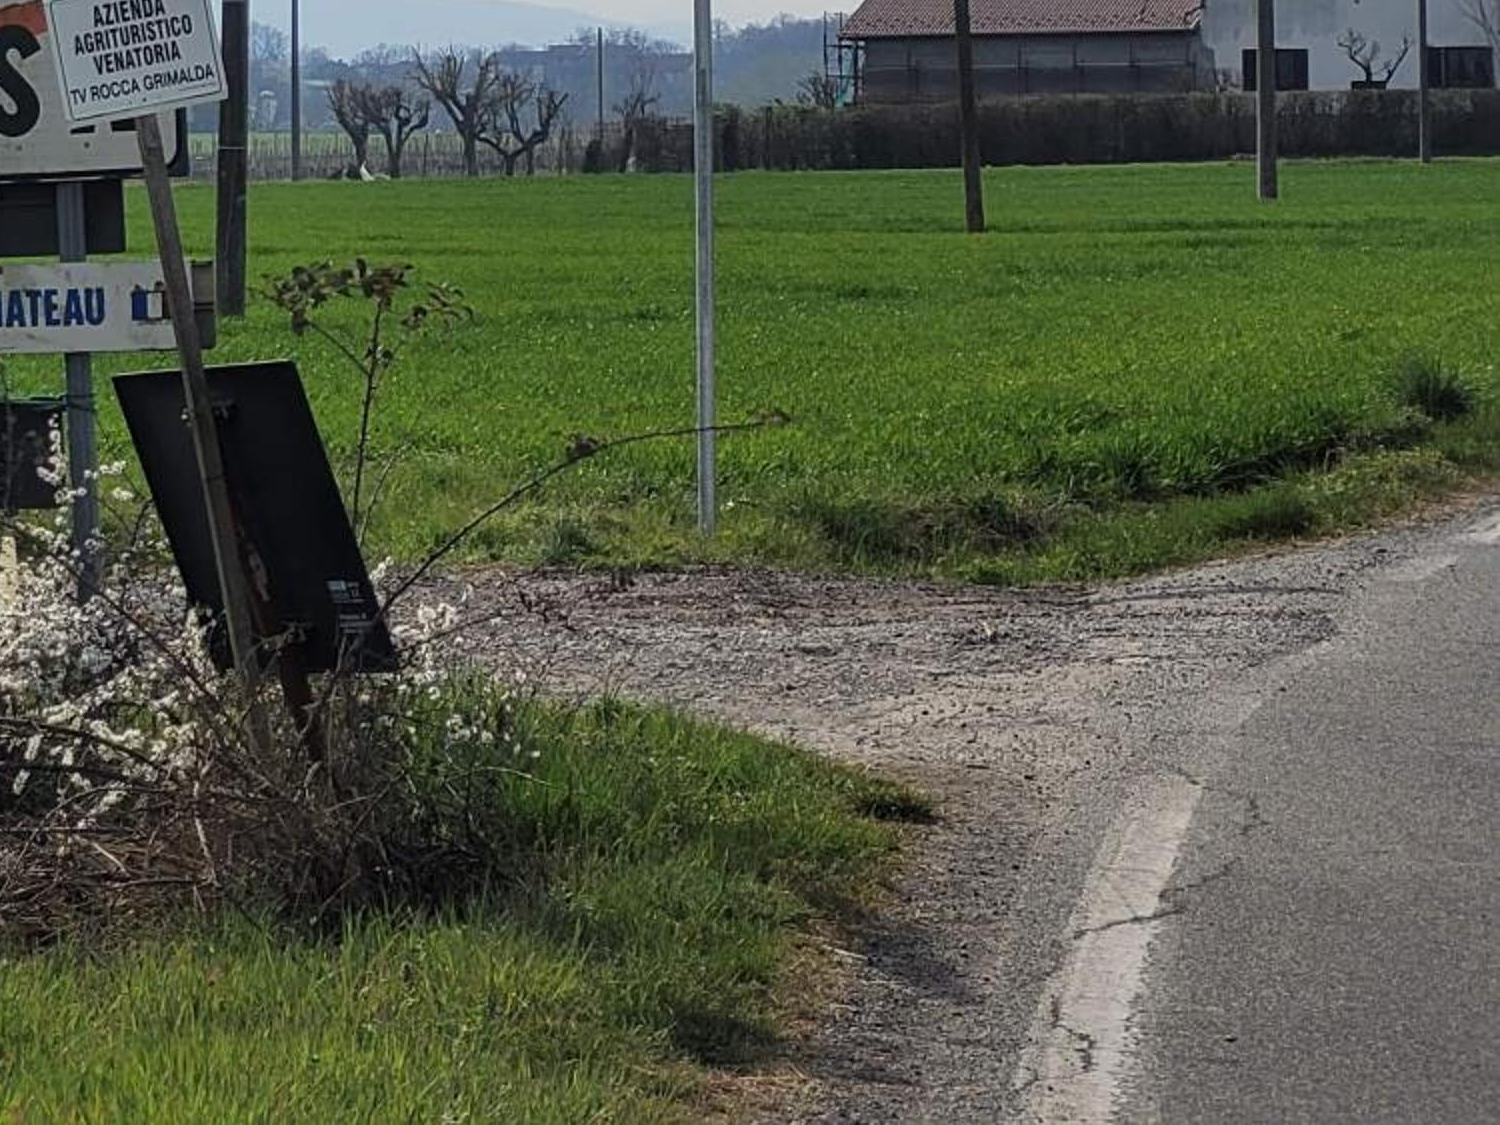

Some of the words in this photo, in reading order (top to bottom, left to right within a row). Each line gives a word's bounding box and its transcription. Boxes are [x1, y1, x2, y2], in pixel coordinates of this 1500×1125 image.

[75, 14, 193, 56] AGRITURISTICO
[93, 41, 181, 76] VENATORIA
[90, 78, 141, 102] ROCCA
[143, 63, 215, 92] GRIMALDA
